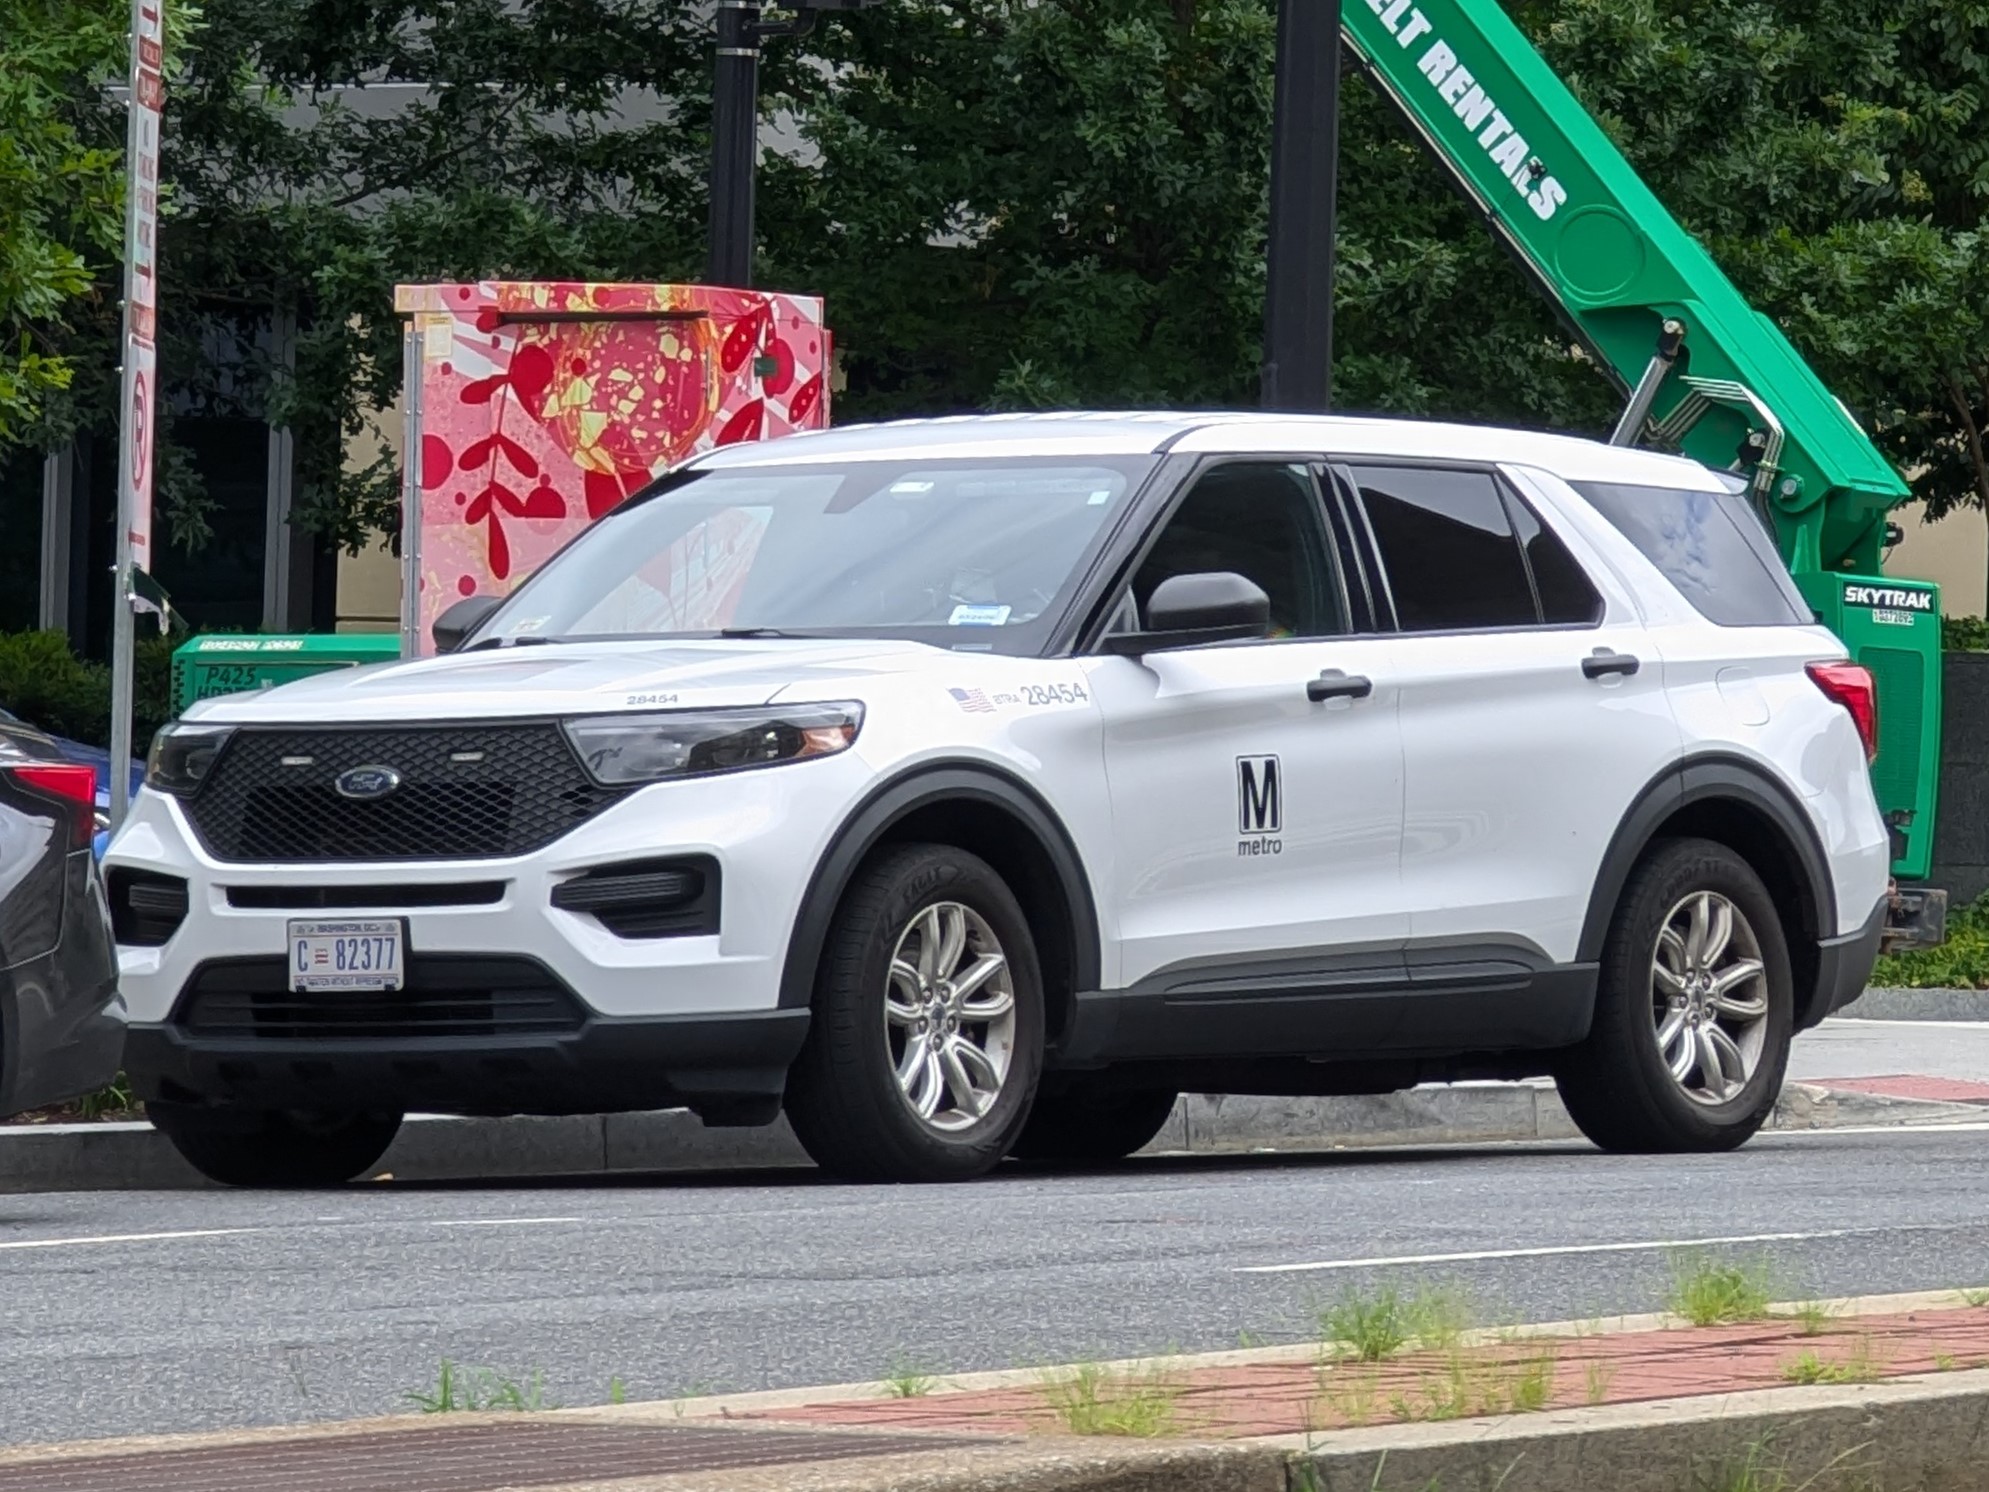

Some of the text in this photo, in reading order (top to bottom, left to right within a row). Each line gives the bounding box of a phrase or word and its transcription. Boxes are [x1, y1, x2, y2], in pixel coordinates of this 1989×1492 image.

[1416, 38, 1568, 221] RENTALS
[1844, 586, 1932, 610] SKYTRAK
[205, 666, 256, 685] P425
[626, 694, 679, 705] 28454
[1019, 682, 1088, 706] 28454
[1240, 759, 1278, 830] M
[1238, 836, 1282, 856] metro
[297, 937, 396, 972] C 82377
